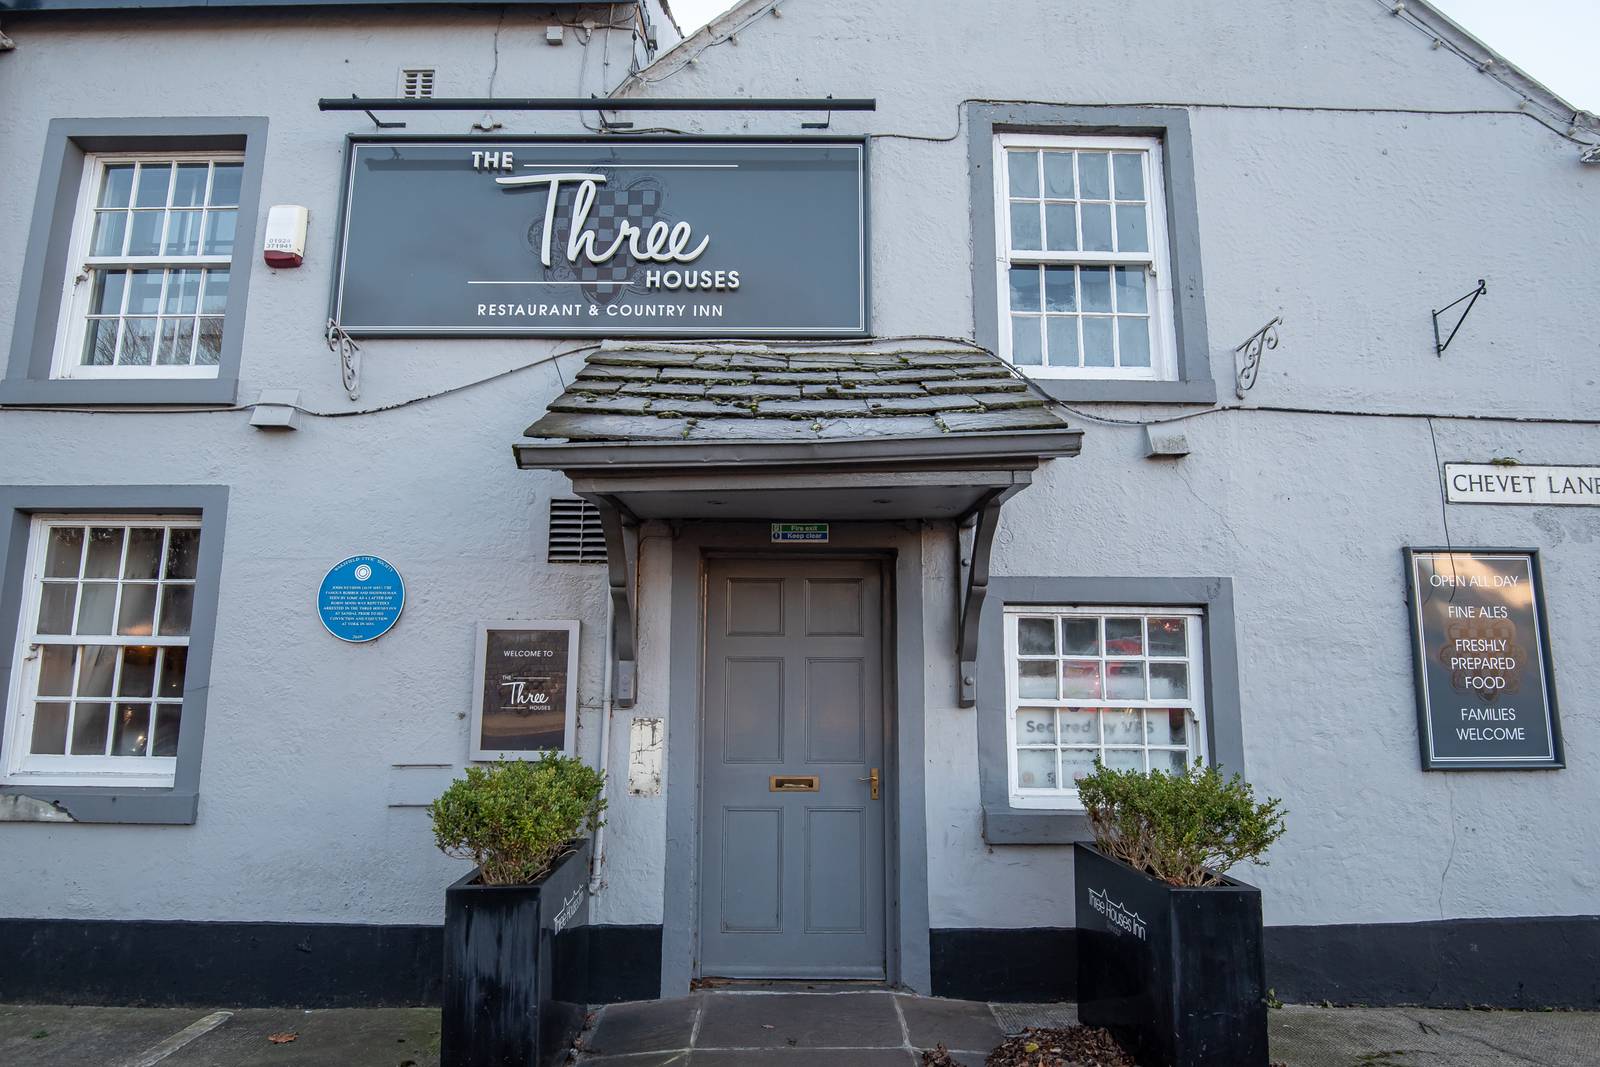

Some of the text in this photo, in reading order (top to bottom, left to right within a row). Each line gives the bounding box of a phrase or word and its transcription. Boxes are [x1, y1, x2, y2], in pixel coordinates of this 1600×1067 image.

[472, 151, 514, 170] THE
[495, 173, 710, 267] Three
[646, 270, 740, 290] HOUSES
[477, 304, 723, 316] RESTAURANT & COUNTRY INN
[1453, 474, 1600, 494] CHEVET LANE
[1430, 574, 1518, 587] OPEN ALL DAY
[1448, 606, 1508, 618] FINE ALES
[1455, 639, 1507, 652] FRESHLY
[1450, 657, 1516, 670] PREPARED
[1464, 676, 1506, 689] FOOD
[501, 681, 550, 705] Three
[1460, 708, 1516, 721] FAMILIES
[1026, 720, 1090, 733] Secred
[1456, 728, 1526, 741] WELCOME
[1106, 902, 1132, 932] Houses
[1132, 918, 1146, 941] Inn
